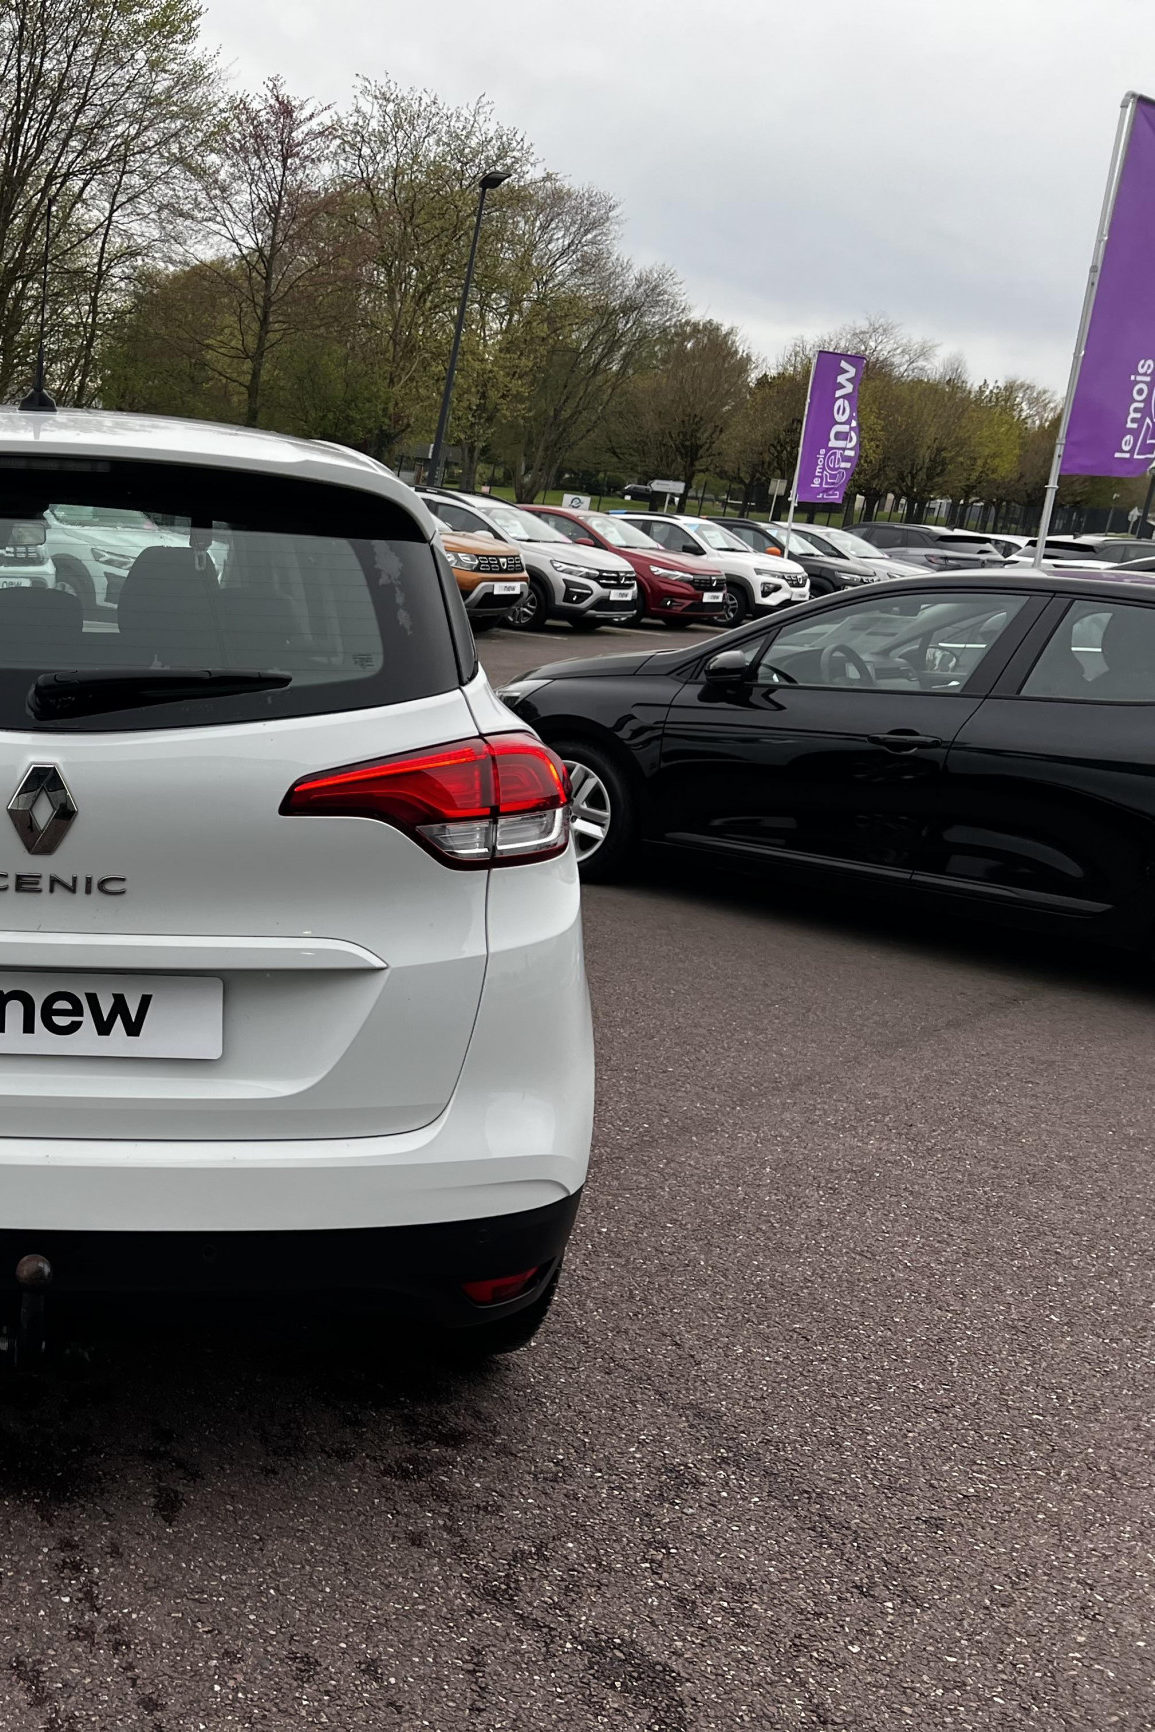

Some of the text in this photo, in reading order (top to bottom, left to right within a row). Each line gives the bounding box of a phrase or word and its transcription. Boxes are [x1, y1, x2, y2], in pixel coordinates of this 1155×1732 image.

[1114, 434, 1134, 459] le
[1126, 359, 1154, 429] mois
[811, 449, 826, 487] le mois
